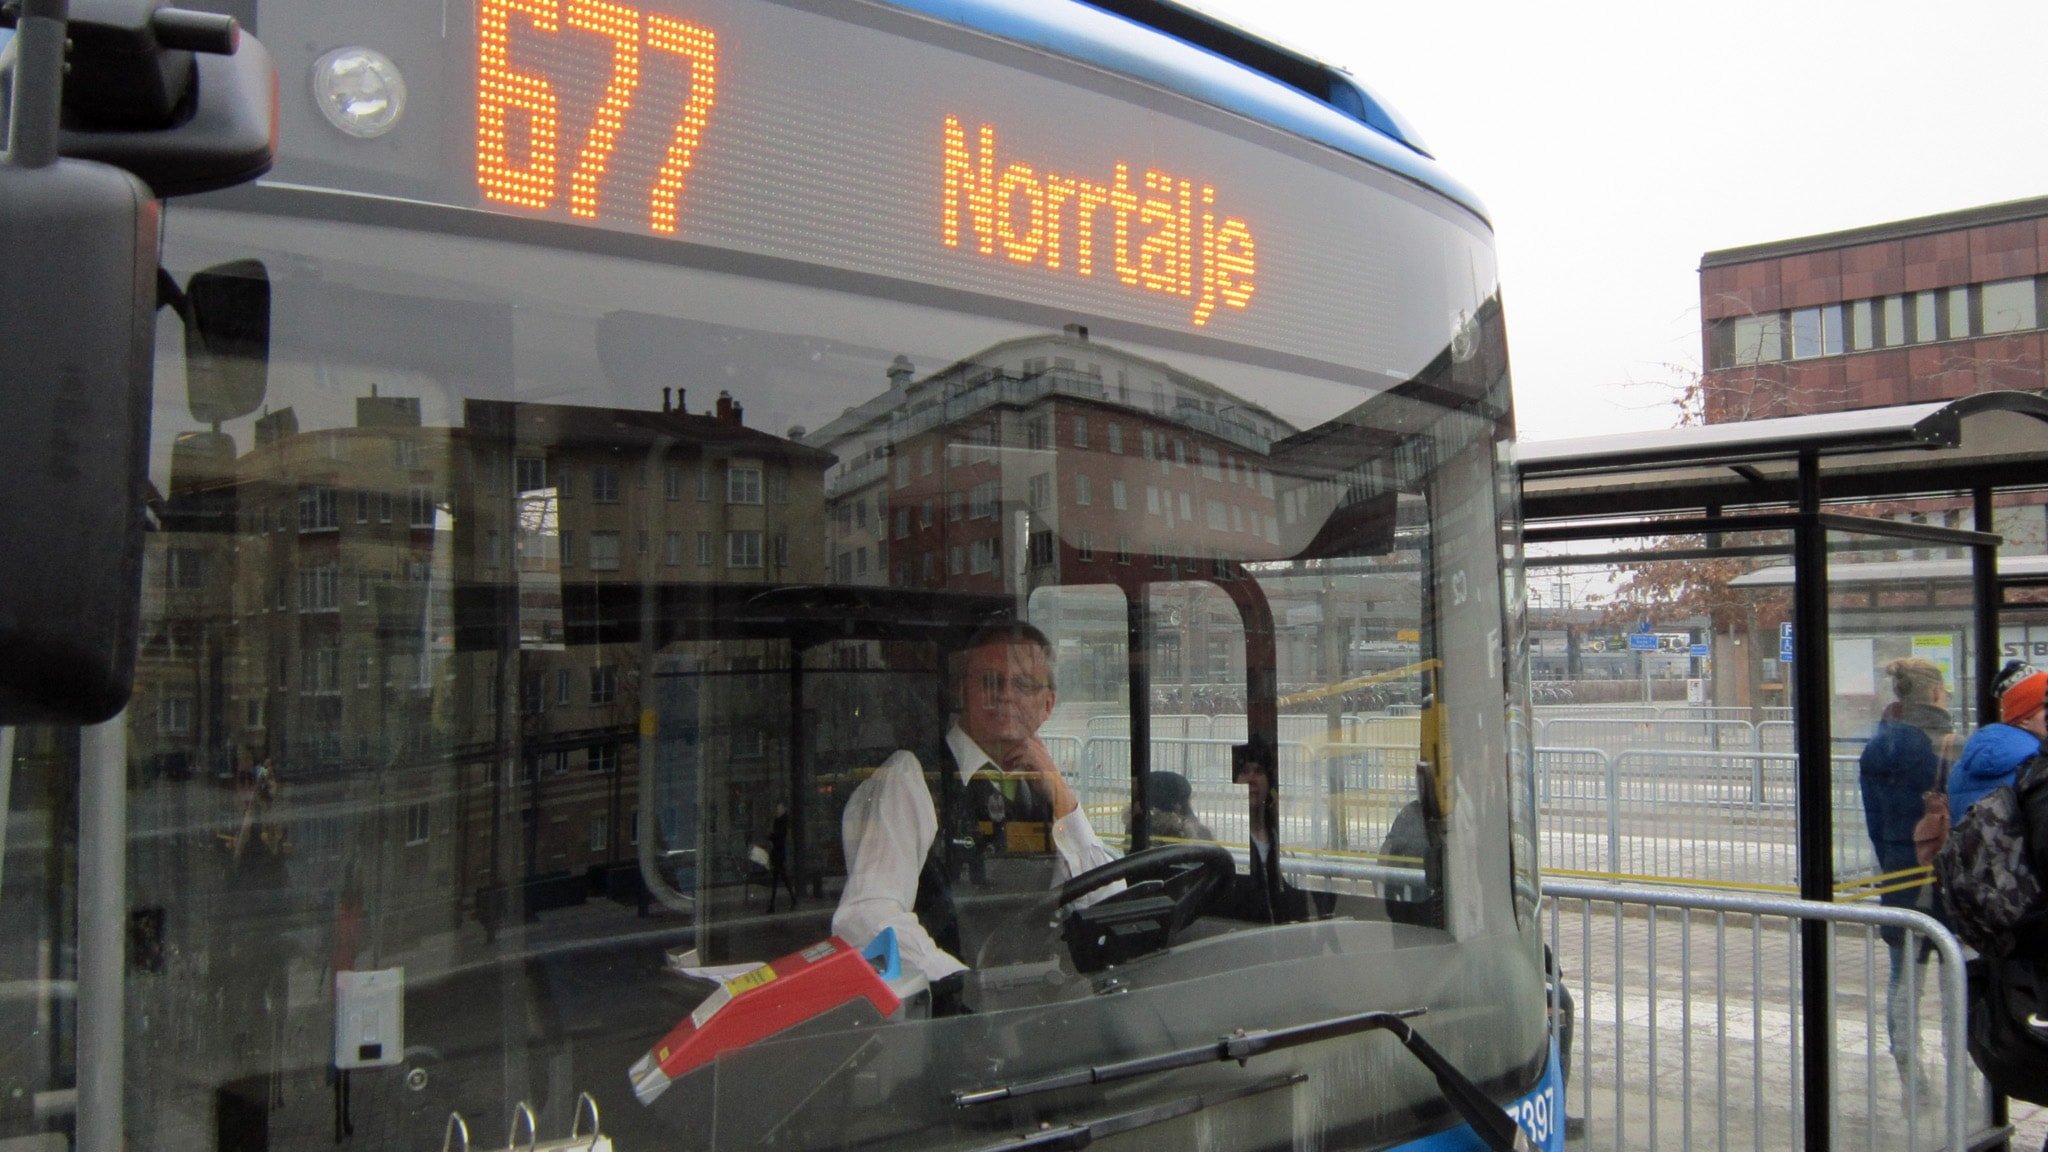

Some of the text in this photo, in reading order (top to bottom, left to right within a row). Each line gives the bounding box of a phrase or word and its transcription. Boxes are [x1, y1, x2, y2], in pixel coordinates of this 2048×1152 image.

[476, 0, 718, 234] 677
[942, 113, 1257, 326] Norrtälje
[1999, 641, 2048, 657] STB
